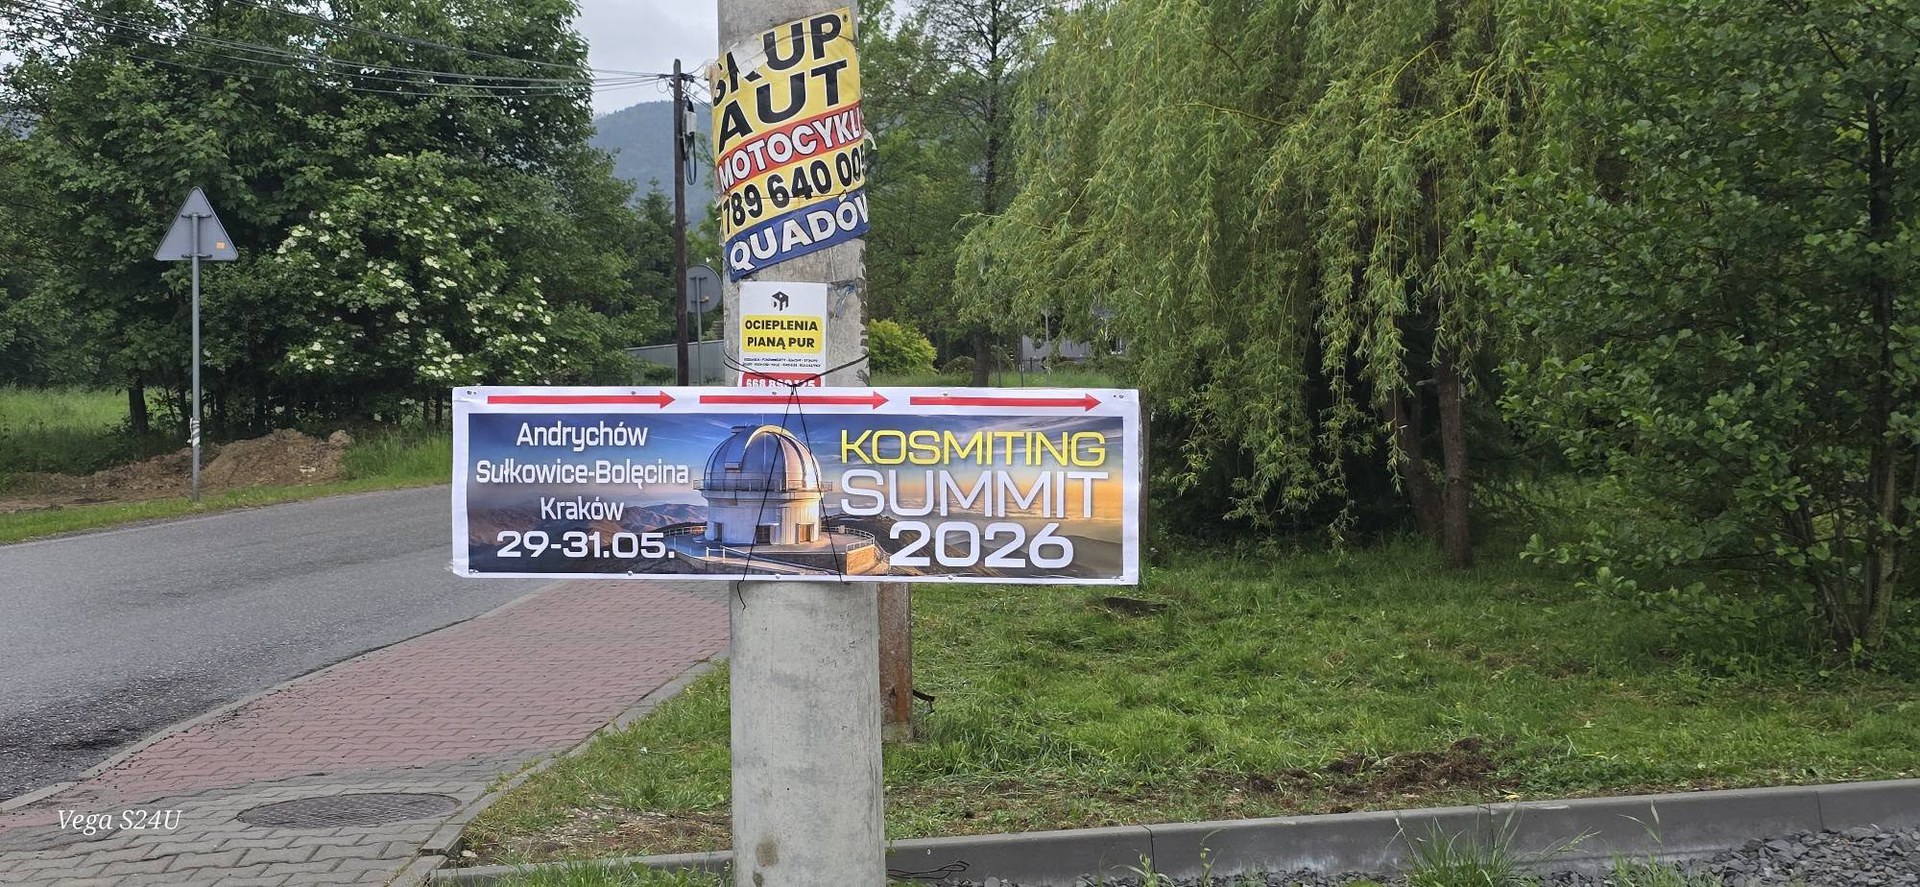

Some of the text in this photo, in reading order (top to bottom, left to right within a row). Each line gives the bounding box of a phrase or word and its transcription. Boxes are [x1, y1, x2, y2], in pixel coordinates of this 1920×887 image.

[719, 60, 848, 154] AUT
[724, 183, 763, 235] 789
[768, 160, 832, 208] 640
[745, 320, 818, 331] OCIEPLENIA
[747, 336, 814, 349] PIANĄ PUR
[516, 421, 648, 452] Andrychów
[841, 429, 1106, 467] KOSMITING
[475, 458, 690, 490] Sułkowice-Bolęcina
[540, 496, 625, 521] Kraków
[841, 469, 1109, 519] SUMMIT
[496, 530, 676, 559] 29-31.05.
[889, 520, 1075, 570] 2026
